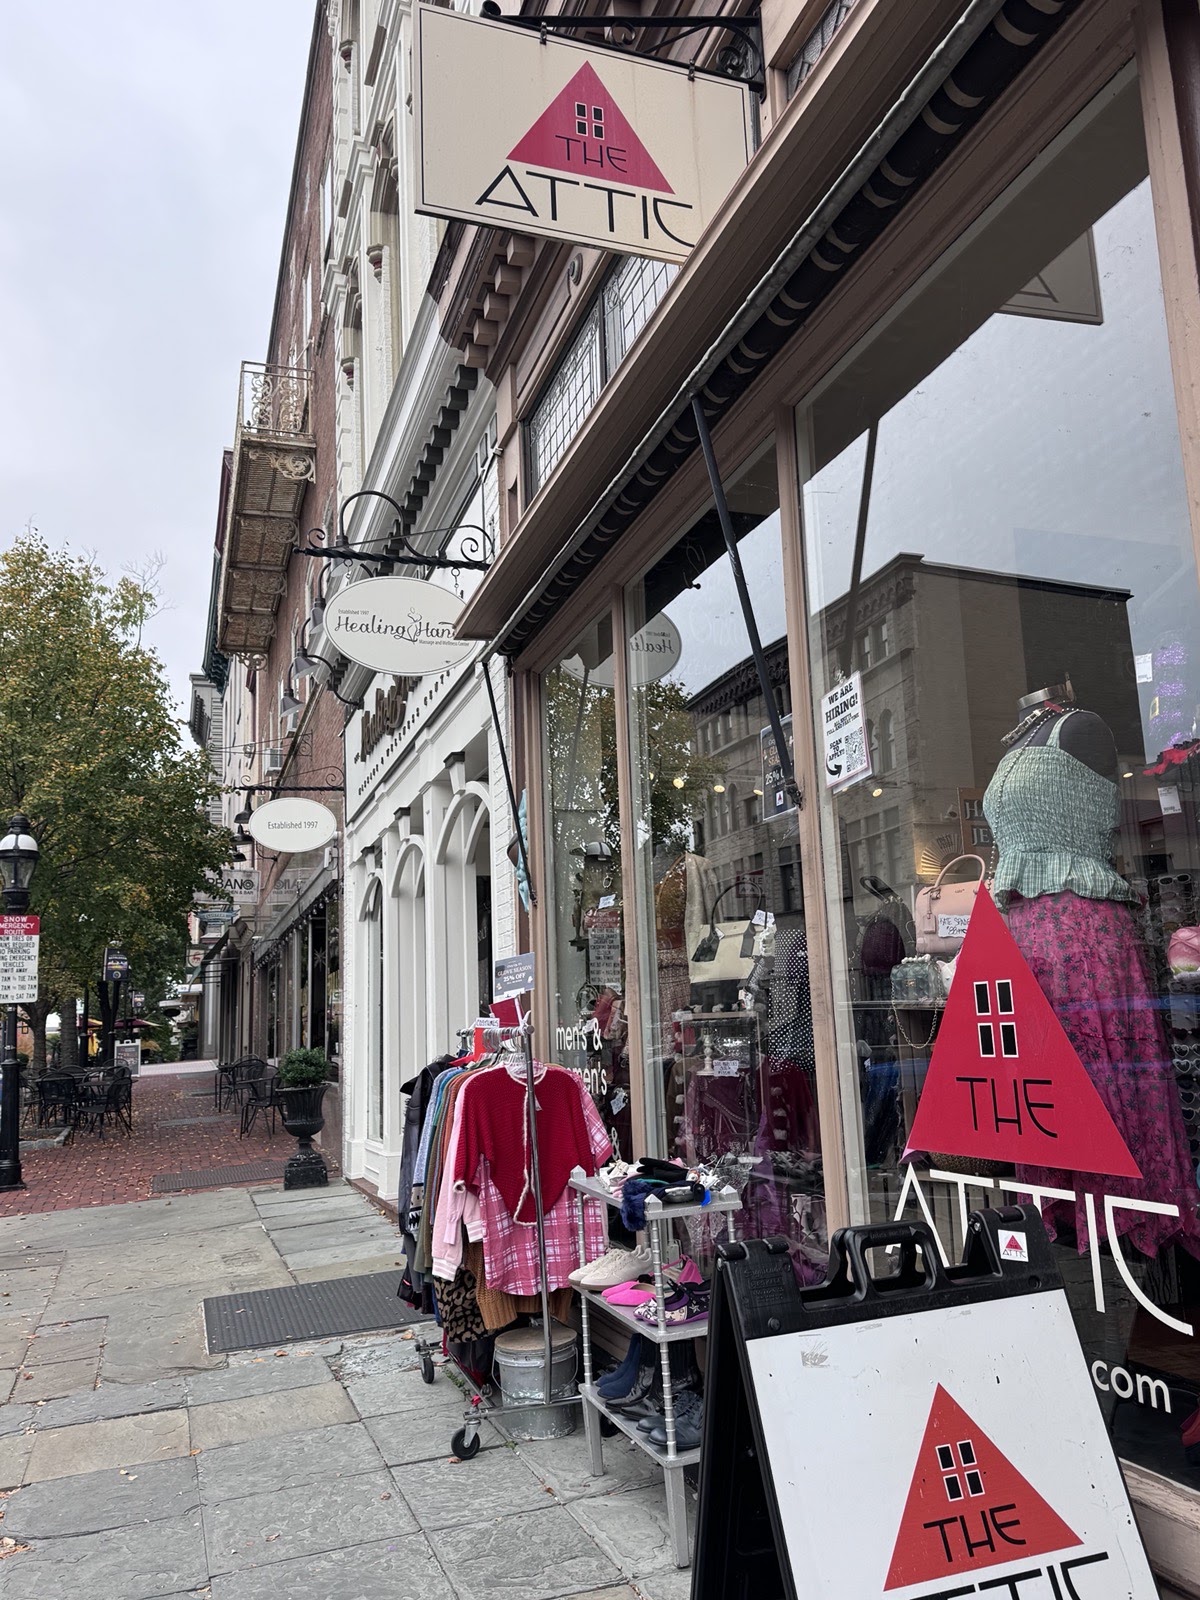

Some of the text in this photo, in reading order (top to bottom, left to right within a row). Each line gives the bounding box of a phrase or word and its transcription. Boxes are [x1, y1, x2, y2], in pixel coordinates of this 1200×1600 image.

[555, 134, 628, 173] THE
[475, 164, 695, 248] ATTIC
[334, 614, 458, 642] Healing Han
[825, 692, 859, 724] HIRING!
[828, 681, 853, 705] WE ARE
[829, 737, 842, 750] SCAN
[832, 745, 840, 754] TO
[765, 768, 780, 786] 25%
[267, 820, 319, 830] Established 1997
[515, 972, 526, 980] OFF
[556, 1017, 603, 1051] men's &
[955, 1076, 1058, 1139] THE
[883, 1161, 1194, 1337] ATTIC
[1090, 1359, 1172, 1414] com
[923, 1502, 1027, 1563] THE
